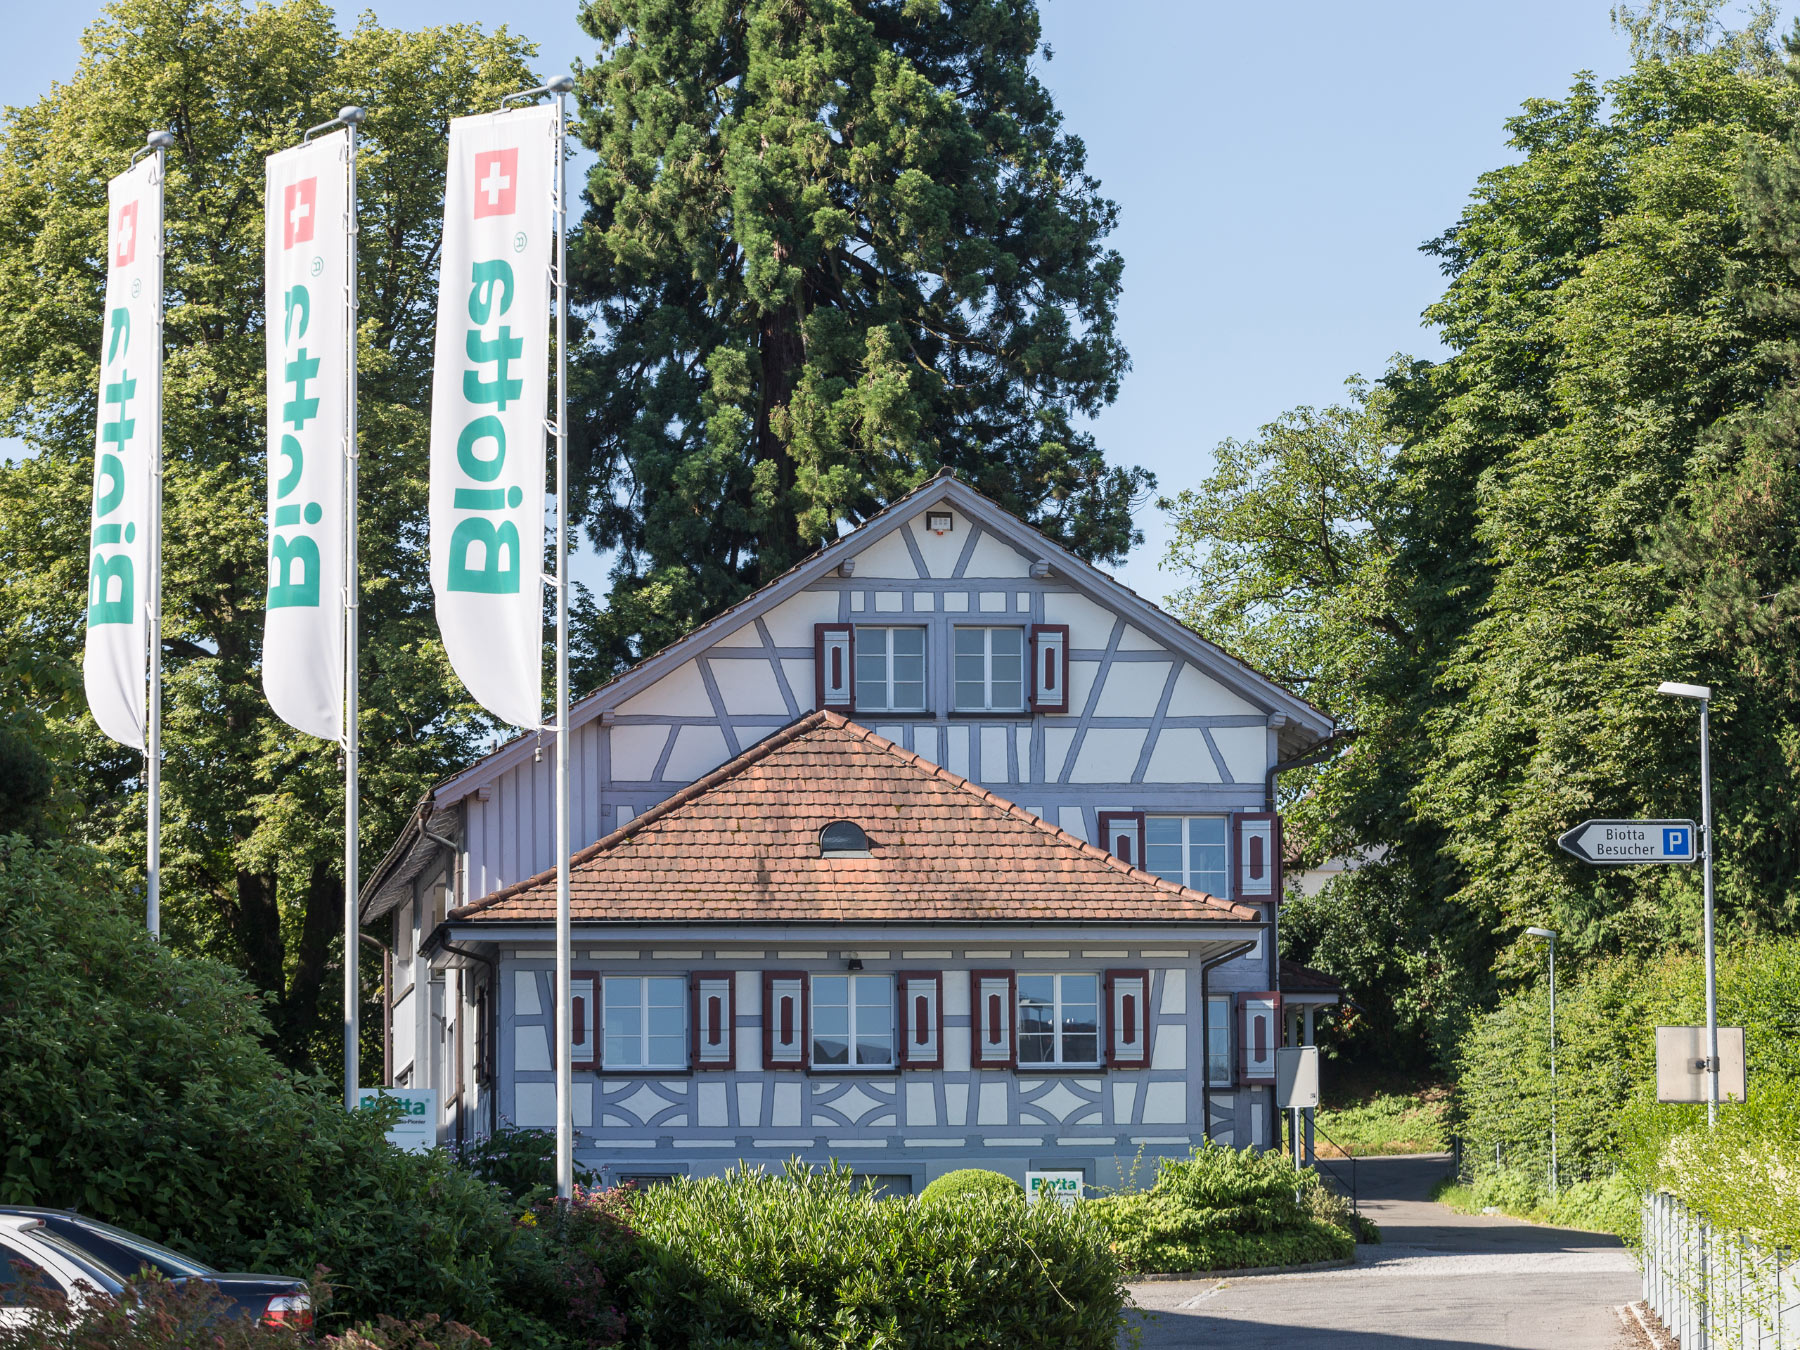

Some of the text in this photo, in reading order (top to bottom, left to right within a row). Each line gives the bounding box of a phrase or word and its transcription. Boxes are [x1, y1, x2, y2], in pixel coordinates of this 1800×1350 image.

[1606, 828, 1645, 841] Biotta
[1669, 832, 1682, 852] P
[1597, 843, 1655, 856] Besucher
[360, 1096, 426, 1116] Btta
[1031, 1177, 1077, 1190] Botta
